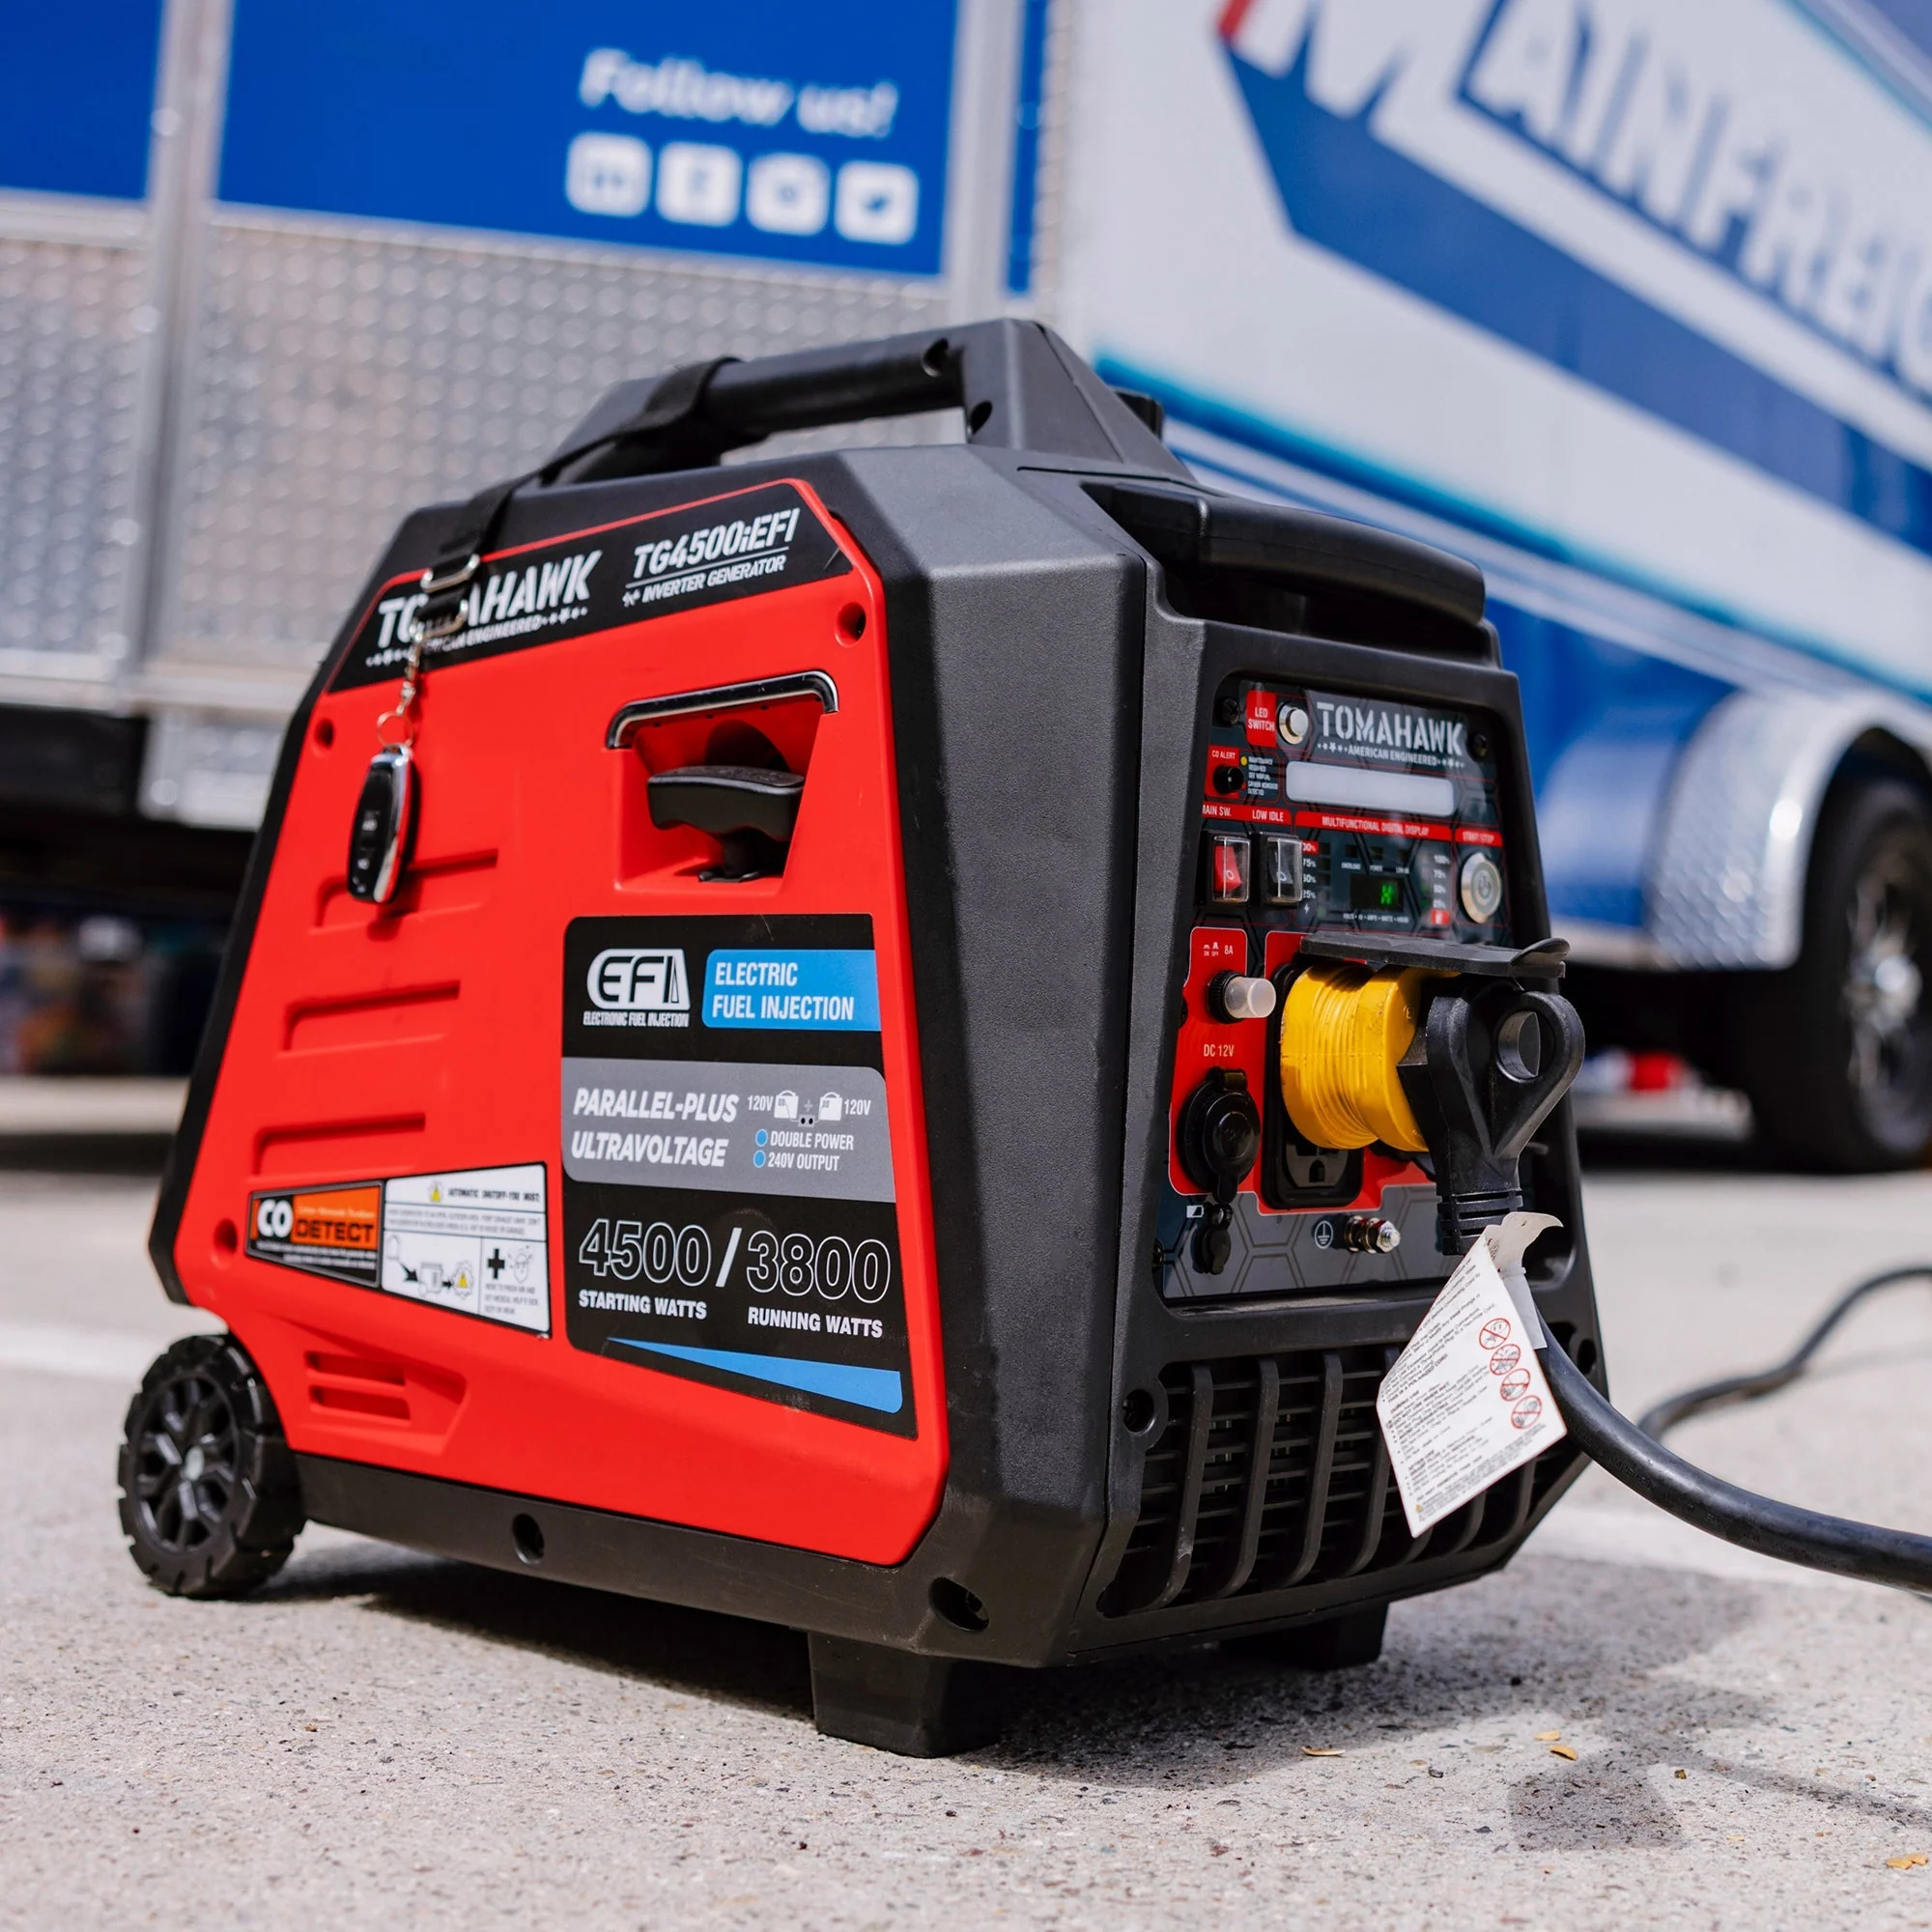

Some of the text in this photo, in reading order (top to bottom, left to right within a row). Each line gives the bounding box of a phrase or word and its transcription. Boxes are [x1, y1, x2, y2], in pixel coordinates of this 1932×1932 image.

[581, 46, 898, 138] Follow us!
[633, 508, 800, 579] TG4500iEFI
[641, 554, 787, 604] INVERTER GENERATOR
[1247, 719, 1275, 731] SWITCH
[1254, 707, 1268, 718] LED
[1317, 701, 1463, 756] TOMAHAWK
[1348, 745, 1437, 767] AMERICAN ENGINEERED
[1252, 810, 1284, 822] LOW IDLE
[1224, 945, 1234, 955] 8A
[592, 952, 683, 1007] EFI
[714, 962, 798, 987] ELECTRIC
[582, 1010, 690, 1028] ELECTRONIC FUEL INJECTION
[712, 995, 854, 1021] FUEL INJECTION
[1204, 1044, 1235, 1058] DC 12V
[573, 1088, 739, 1123] PARALLEL-PLUS
[747, 1094, 774, 1112] 120V
[844, 1099, 871, 1116] 120V
[571, 1130, 729, 1168] ULTRAVOLTAGE
[770, 1130, 854, 1151] DOUBLE POWER
[767, 1151, 839, 1172] 240V OUTPUT
[257, 1199, 294, 1237] CO
[297, 1218, 374, 1243] DETECT
[579, 1289, 707, 1321] STARTING WATTS
[748, 1307, 883, 1339] RUNNING WATTS
